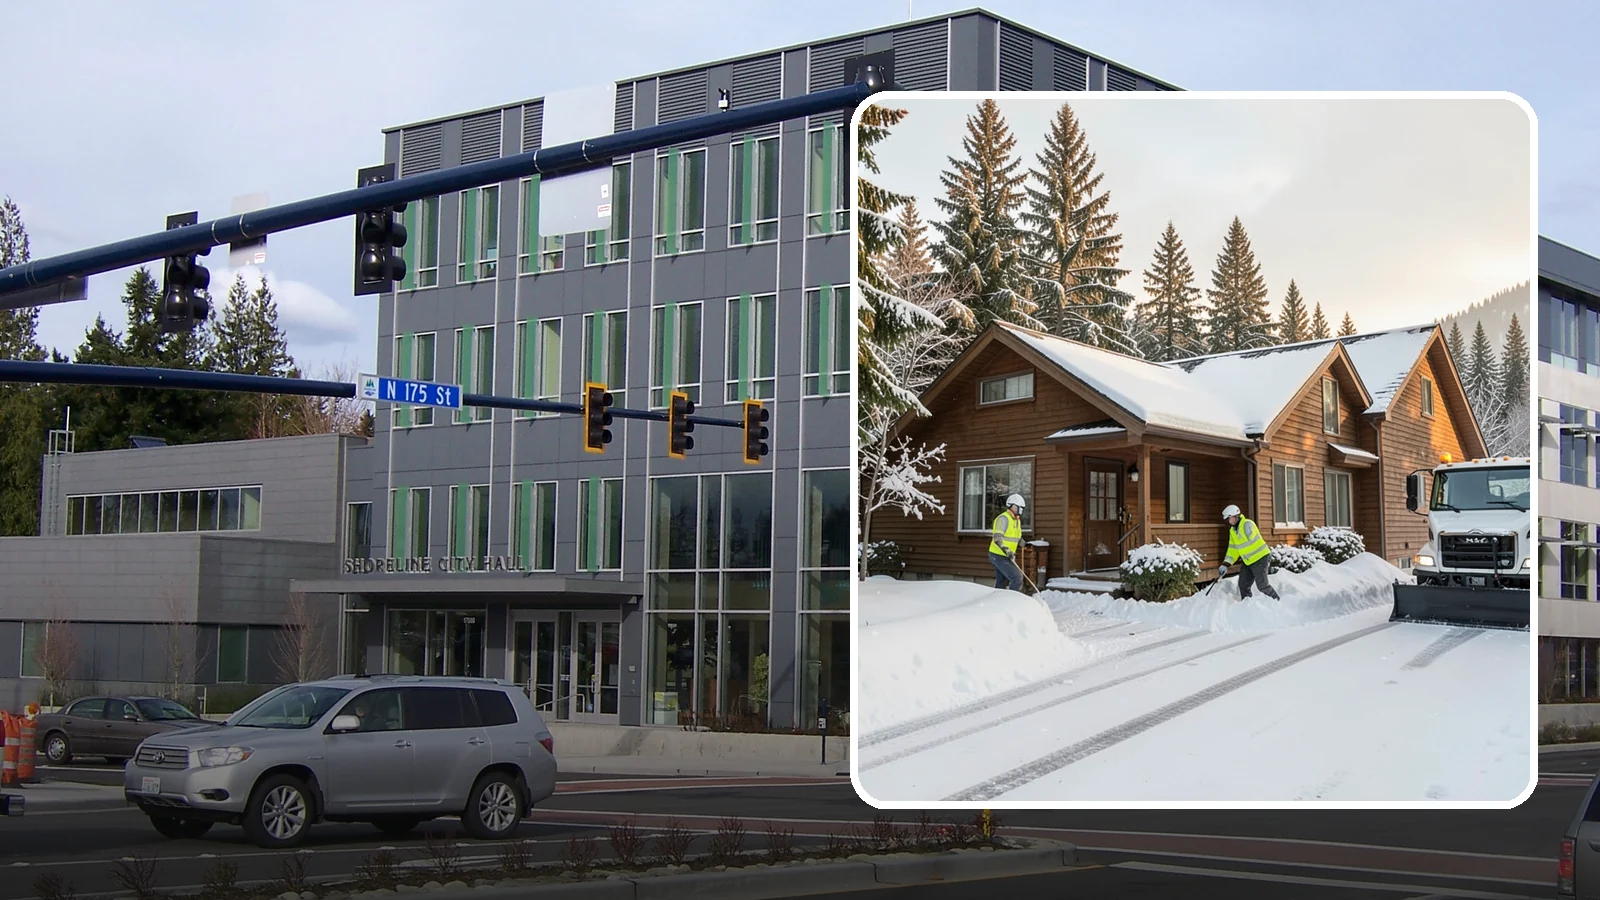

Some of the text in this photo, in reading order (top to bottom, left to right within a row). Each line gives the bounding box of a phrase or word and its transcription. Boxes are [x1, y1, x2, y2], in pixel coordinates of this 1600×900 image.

[387, 380, 451, 406] N 175 St
[344, 556, 525, 573] SHORELINE CITY HALL
